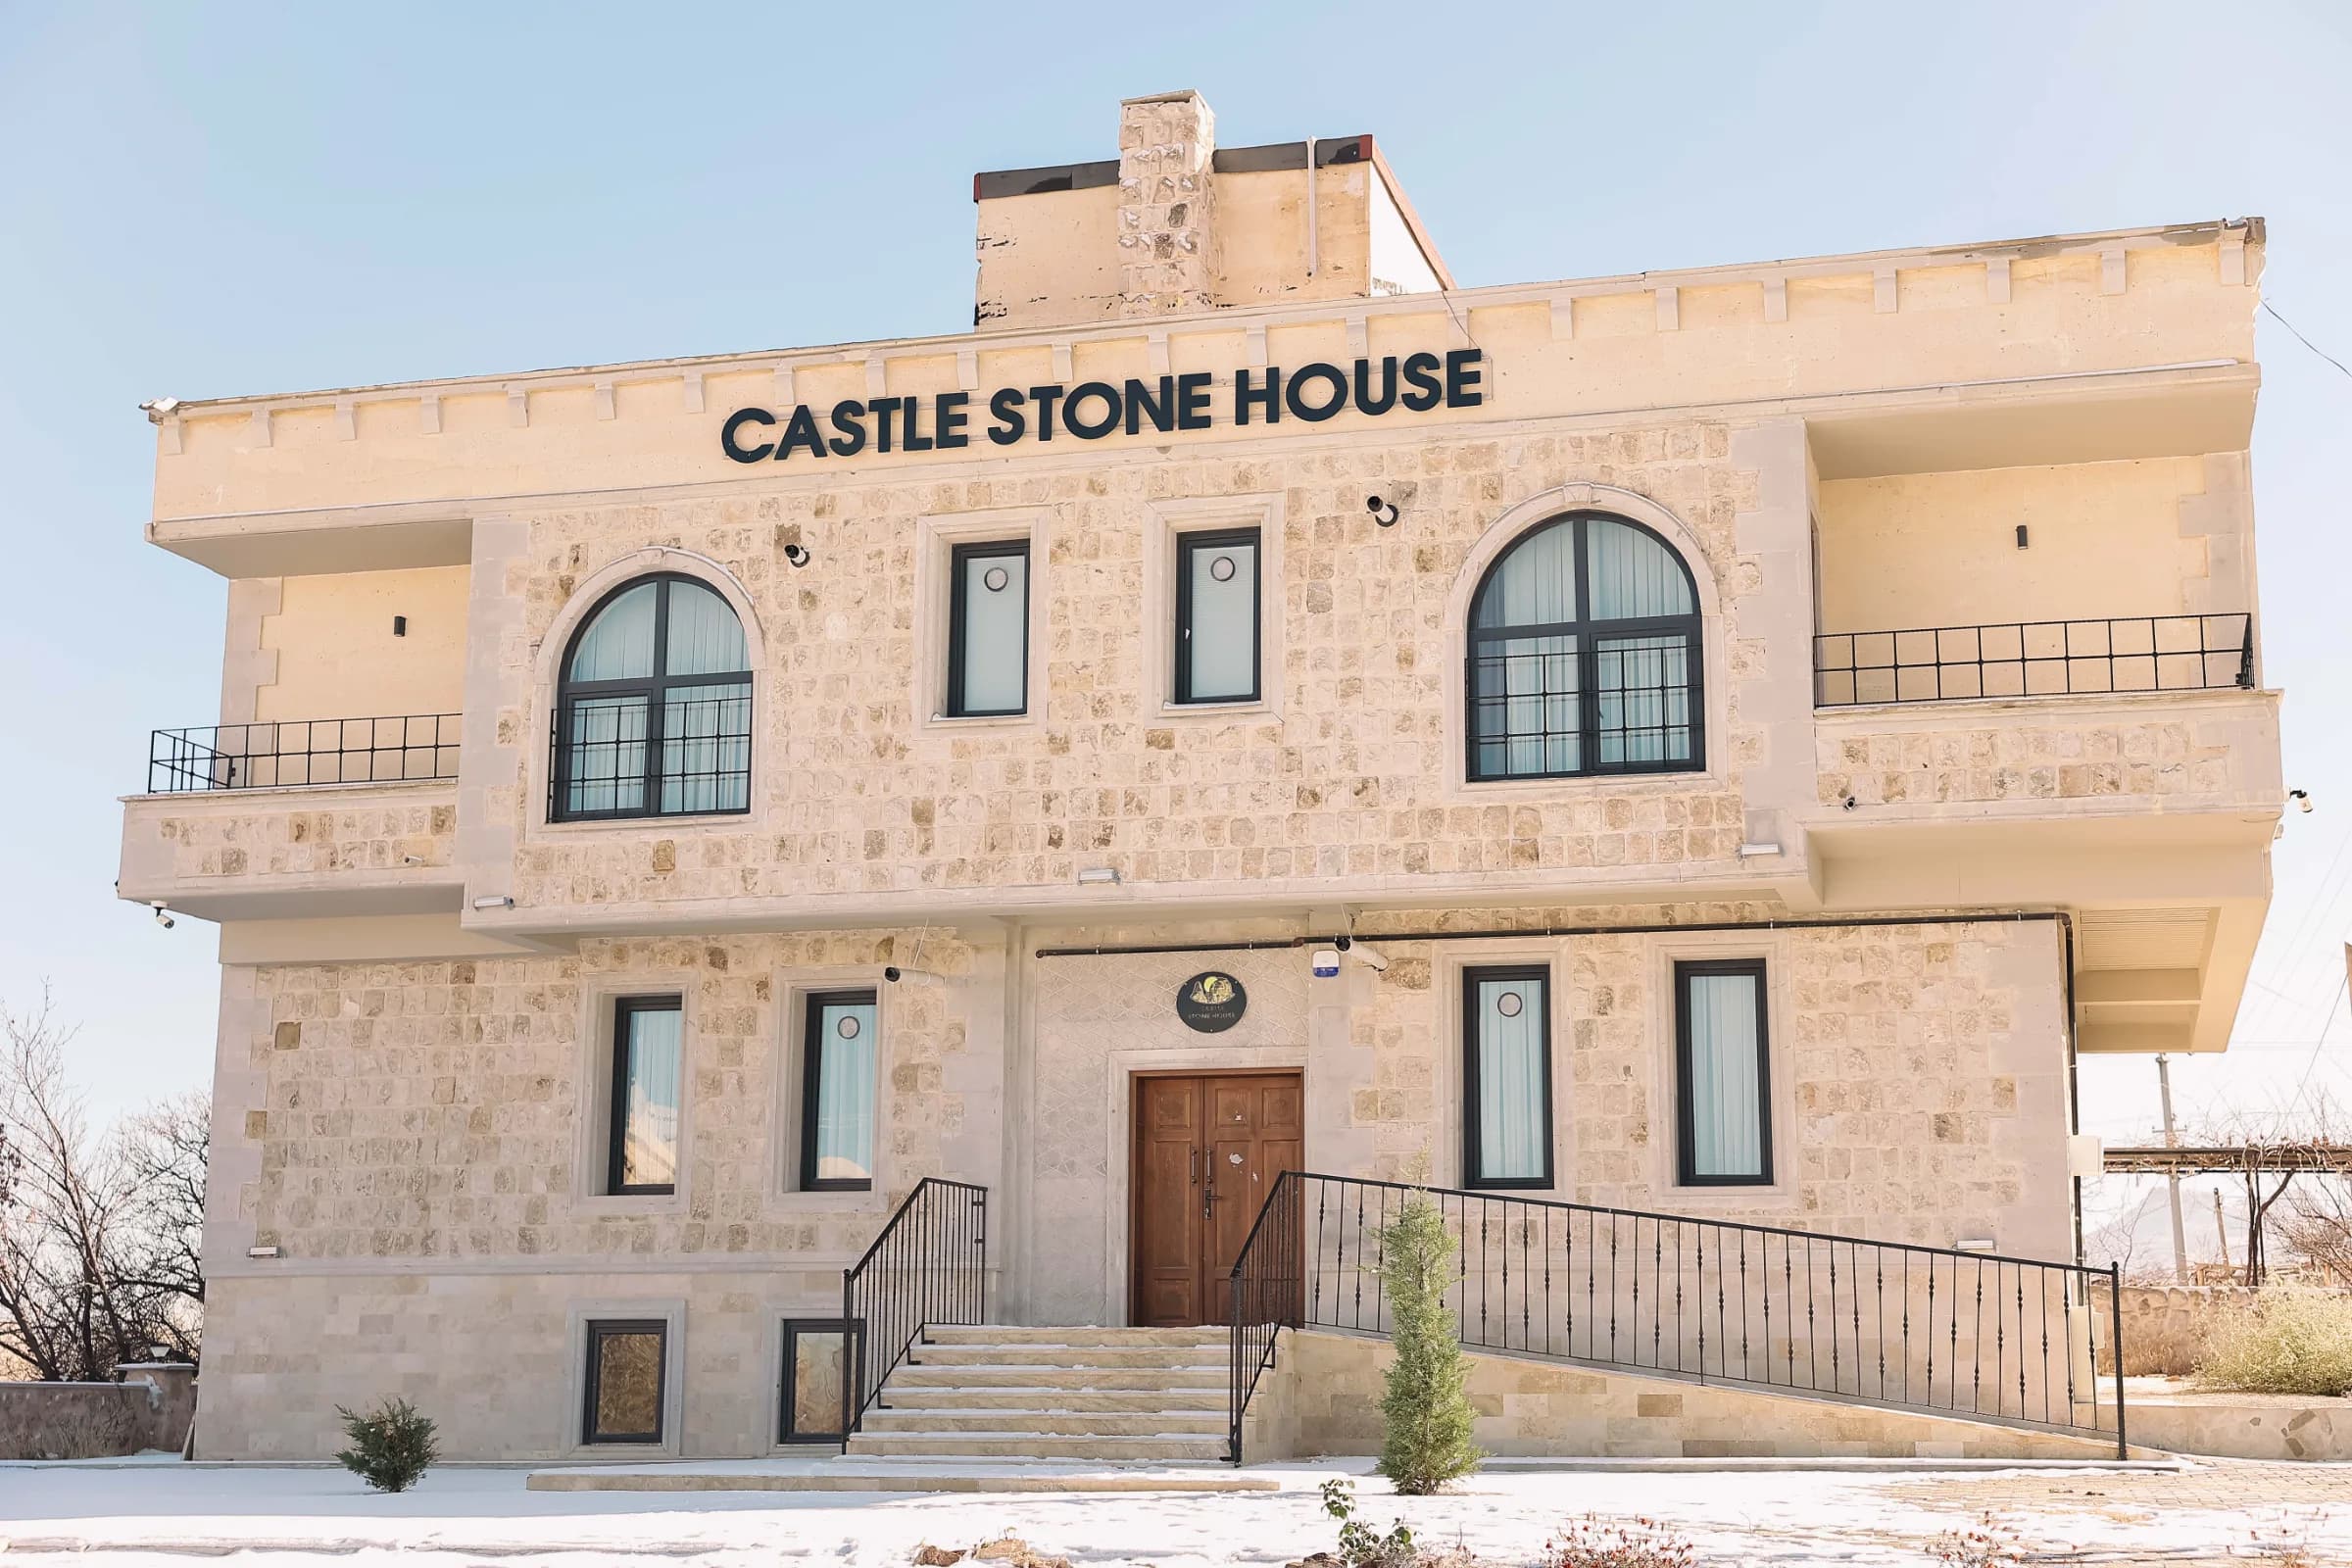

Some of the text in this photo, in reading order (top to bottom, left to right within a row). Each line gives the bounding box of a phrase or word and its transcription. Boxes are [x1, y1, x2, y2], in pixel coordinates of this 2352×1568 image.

[721, 348, 1483, 465] CASTLE STONE HOUSE
